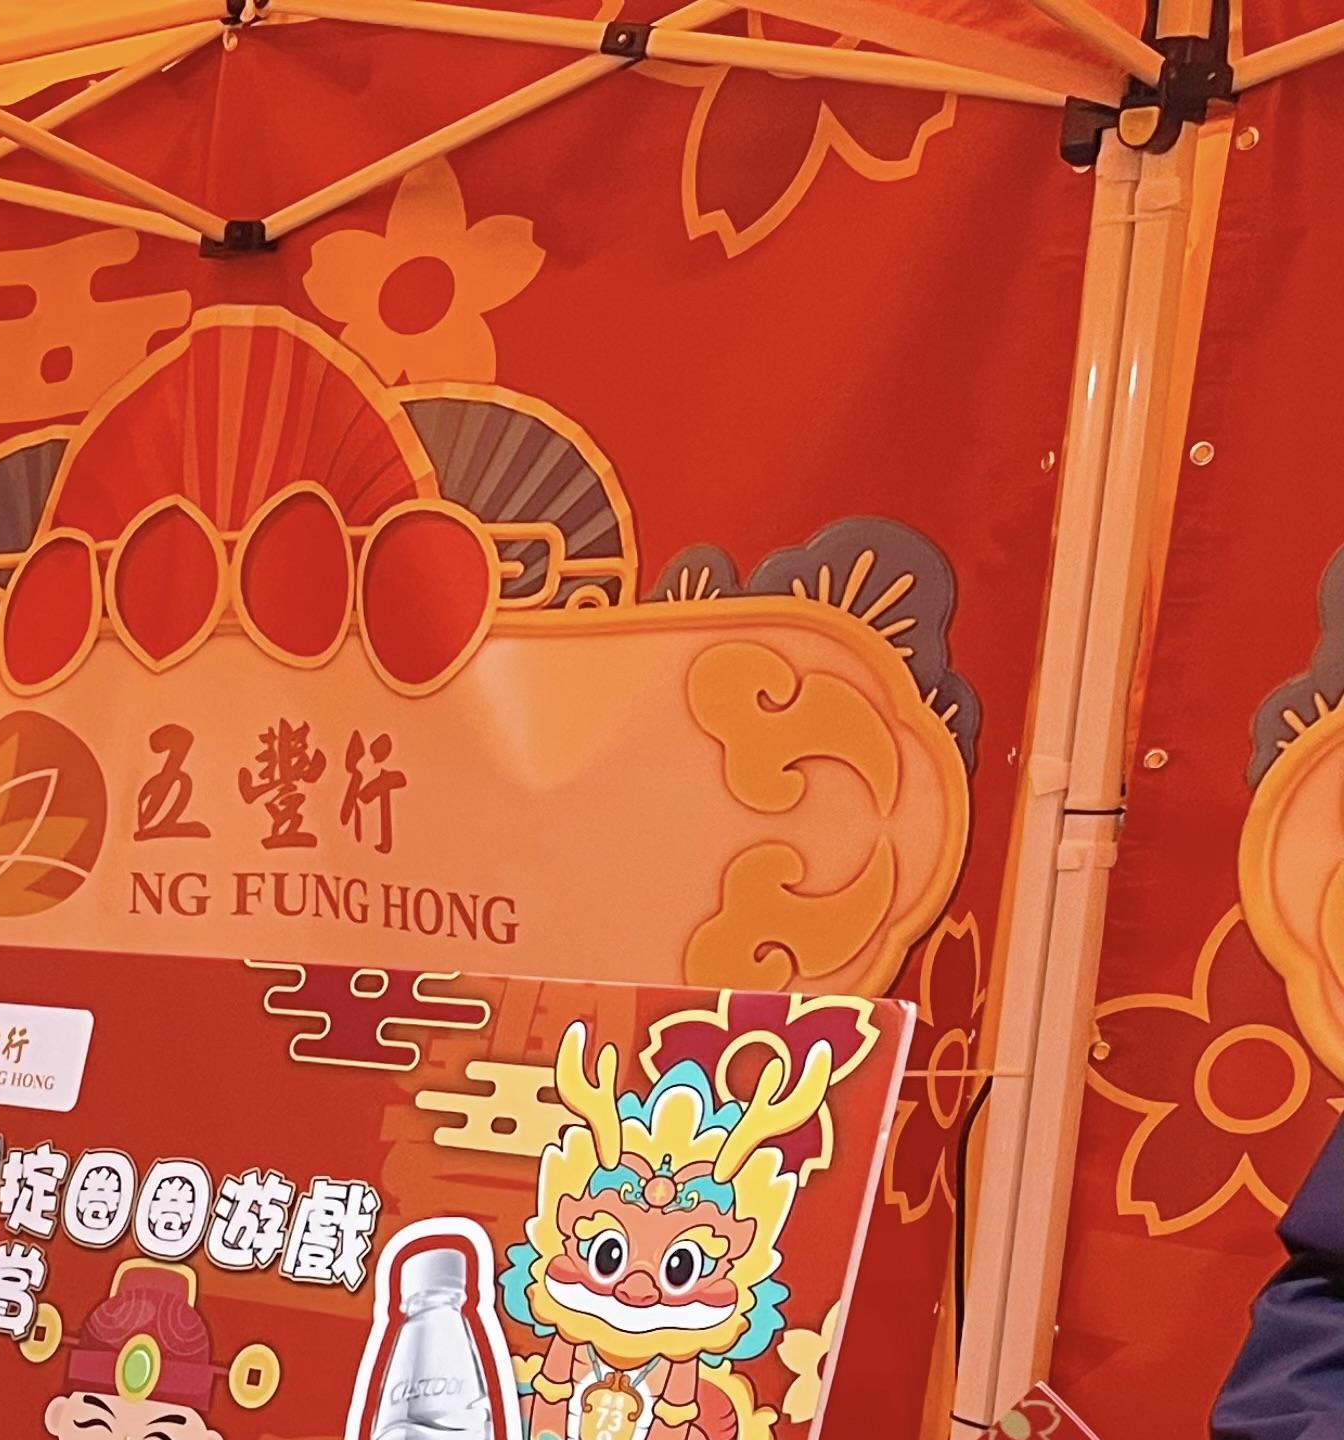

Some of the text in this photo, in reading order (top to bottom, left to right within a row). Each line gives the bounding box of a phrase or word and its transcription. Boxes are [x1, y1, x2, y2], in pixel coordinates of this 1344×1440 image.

[133, 717, 406, 856] 五豐行
[129, 872, 520, 945] NG FUNG HONG
[10, 1071, 55, 1092] HONG
